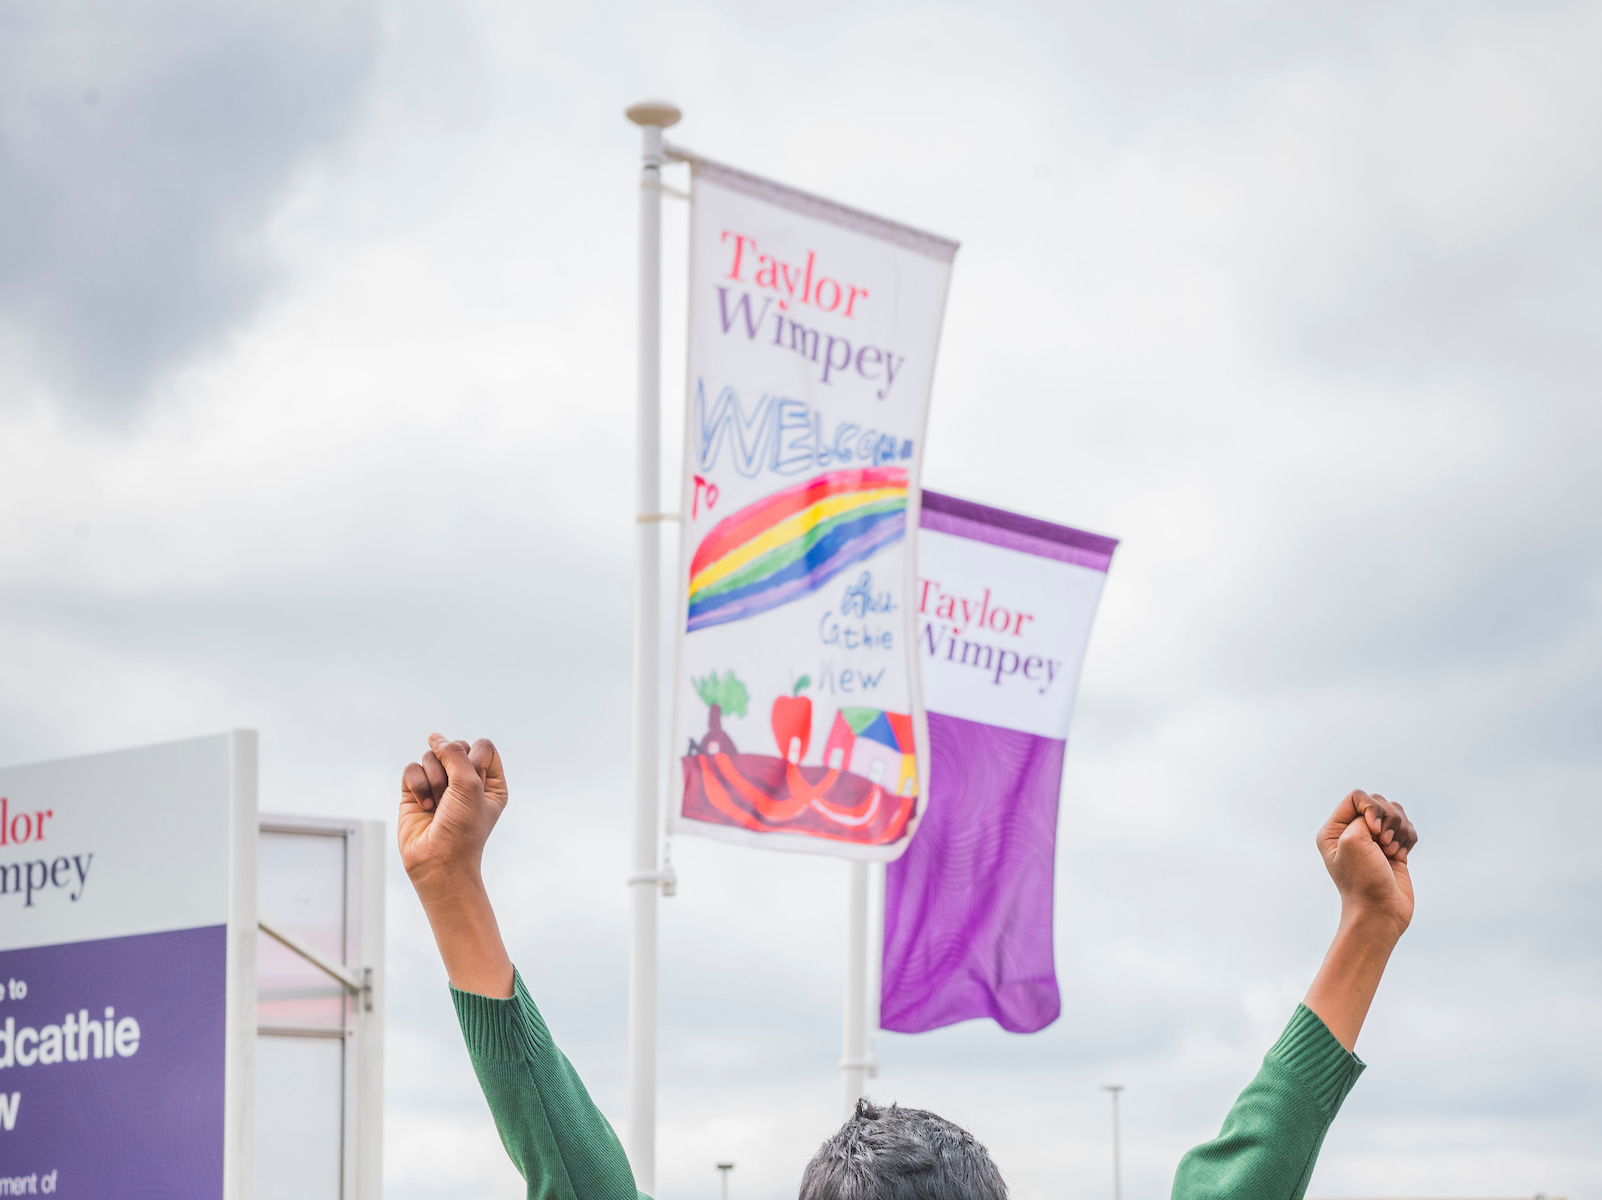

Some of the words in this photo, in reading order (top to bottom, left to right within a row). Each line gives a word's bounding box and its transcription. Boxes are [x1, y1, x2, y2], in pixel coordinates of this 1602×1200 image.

[720, 230, 869, 319] Taylor
[714, 285, 905, 400] Wimpey
[916, 577, 1035, 637] Taylor
[8, 976, 28, 1001] to
[40, 1168, 59, 1194] of
